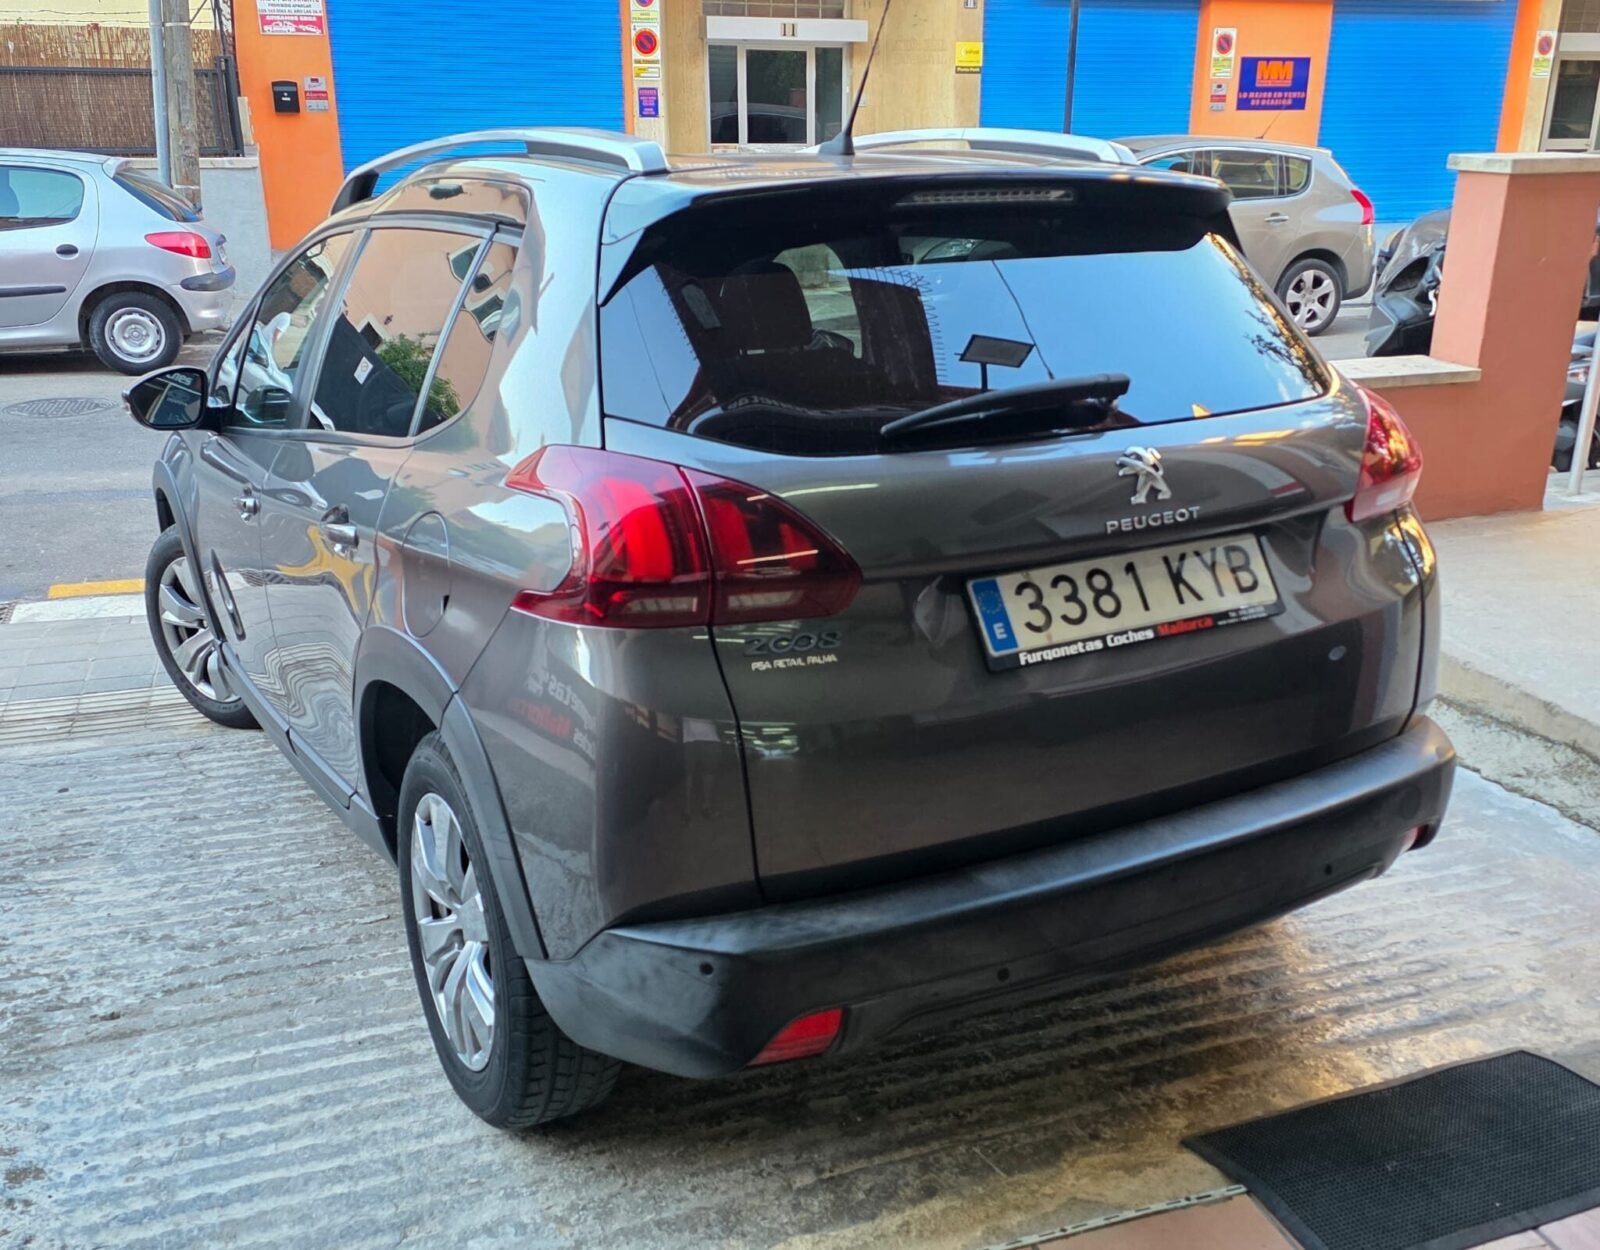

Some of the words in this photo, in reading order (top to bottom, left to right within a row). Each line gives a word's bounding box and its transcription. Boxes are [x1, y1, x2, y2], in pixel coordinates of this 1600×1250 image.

[1106, 506, 1200, 534] PEUGEOT
[1014, 561, 1150, 633] 3381
[1161, 545, 1259, 605] KYB
[993, 623, 1008, 640] E
[1019, 639, 1103, 665] Furgonetas
[1106, 629, 1155, 648] Coches
[1157, 616, 1215, 637] Mallorca
[744, 633, 841, 656] 2008
[773, 658, 806, 669] RETAIL
[806, 653, 838, 665] PALMA
